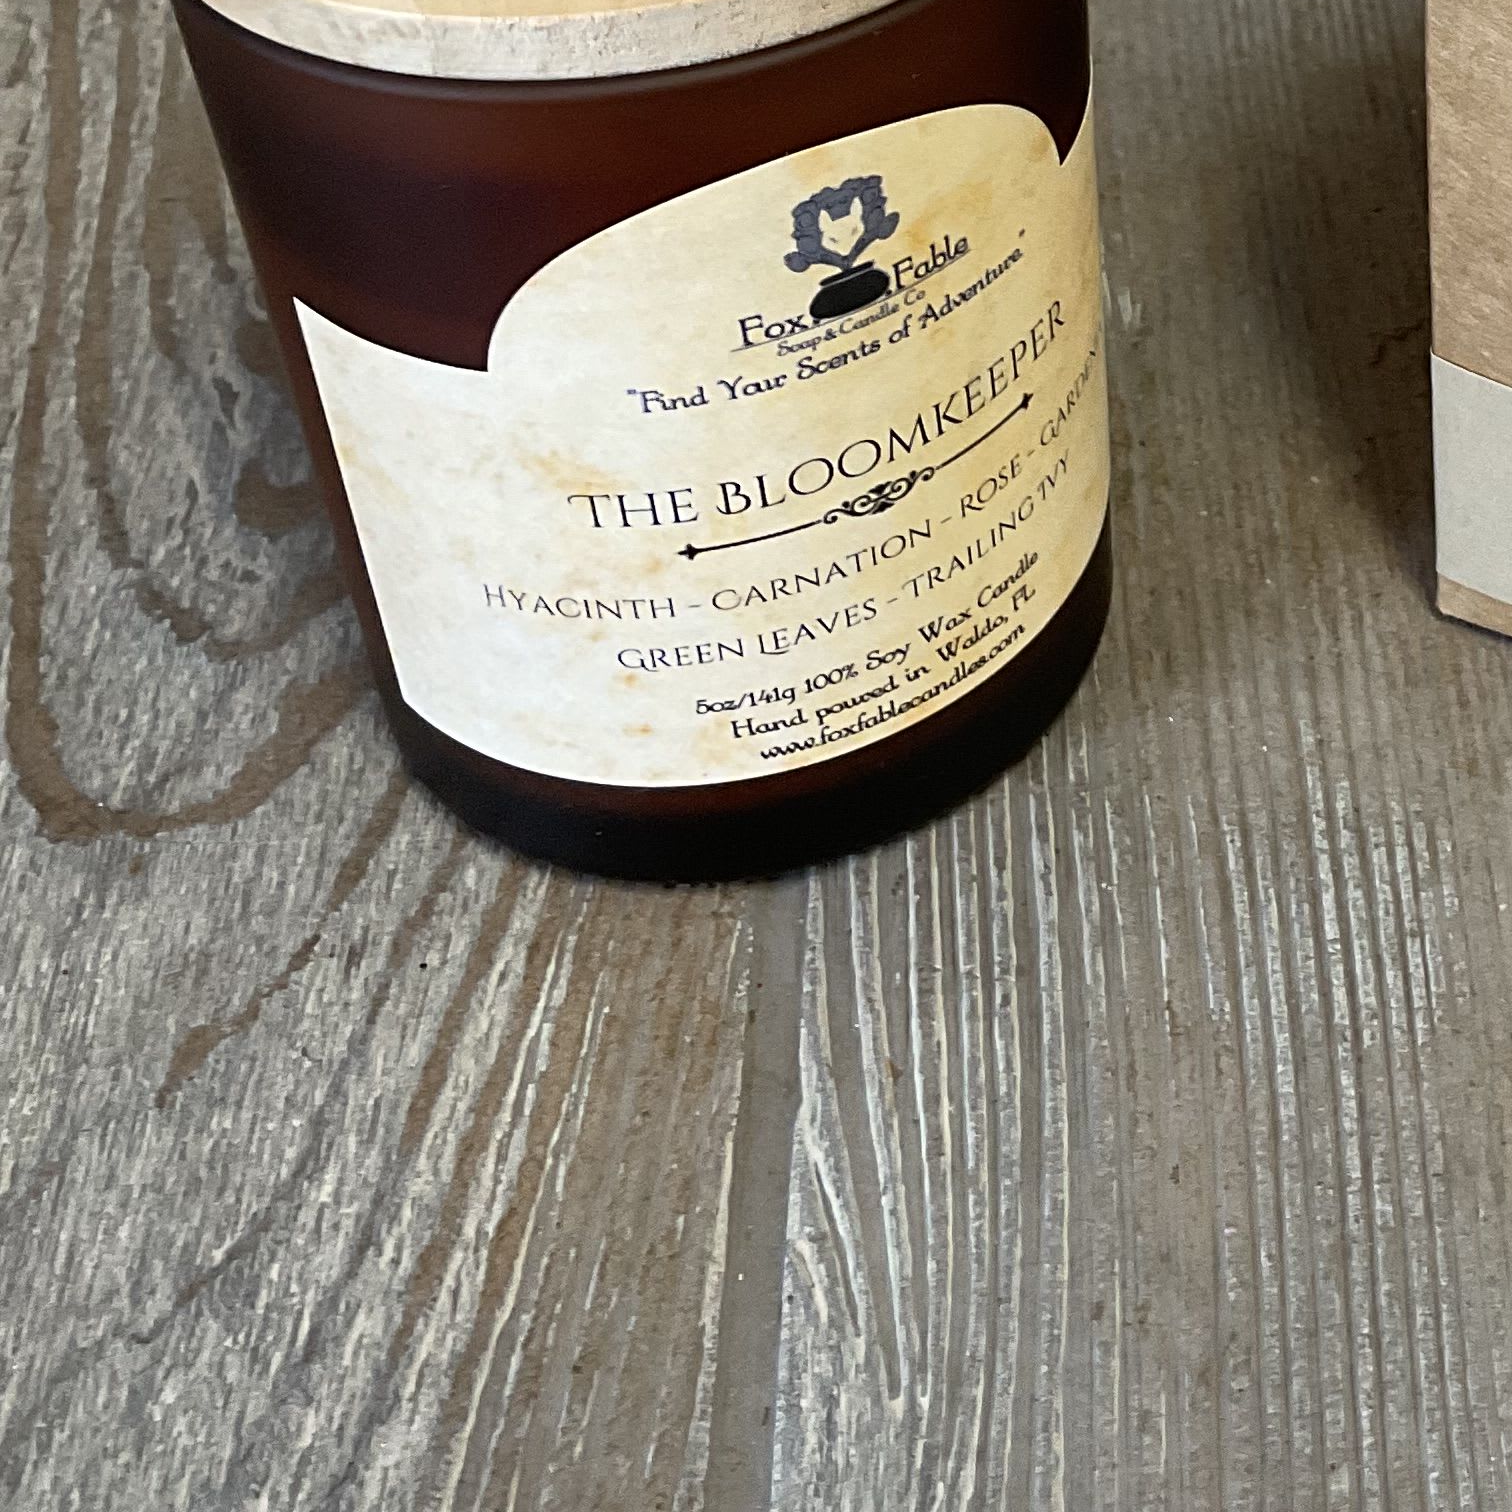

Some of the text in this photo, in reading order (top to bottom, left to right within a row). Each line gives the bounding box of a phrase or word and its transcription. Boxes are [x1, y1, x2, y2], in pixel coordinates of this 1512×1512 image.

[738, 234, 969, 345] Fox Fable
[776, 335, 822, 357] Soap
[837, 299, 899, 334] Candle
[904, 288, 926, 306] Co
[797, 339, 881, 380] Scents
[889, 314, 912, 344] of
[567, 300, 1068, 529] THE BLOOMKEEPER
[484, 584, 675, 621] HYACINTH
[712, 518, 933, 611] CARNATION
[960, 453, 1021, 518] ROSE
[617, 638, 744, 673] GREEN
[760, 598, 878, 655] LEAVES
[901, 496, 1034, 598] TRAILING
[696, 551, 1039, 715] 5oz/141g 100% Soy Wax Candle
[731, 584, 1036, 738] Hand poured in Waldo, FL
